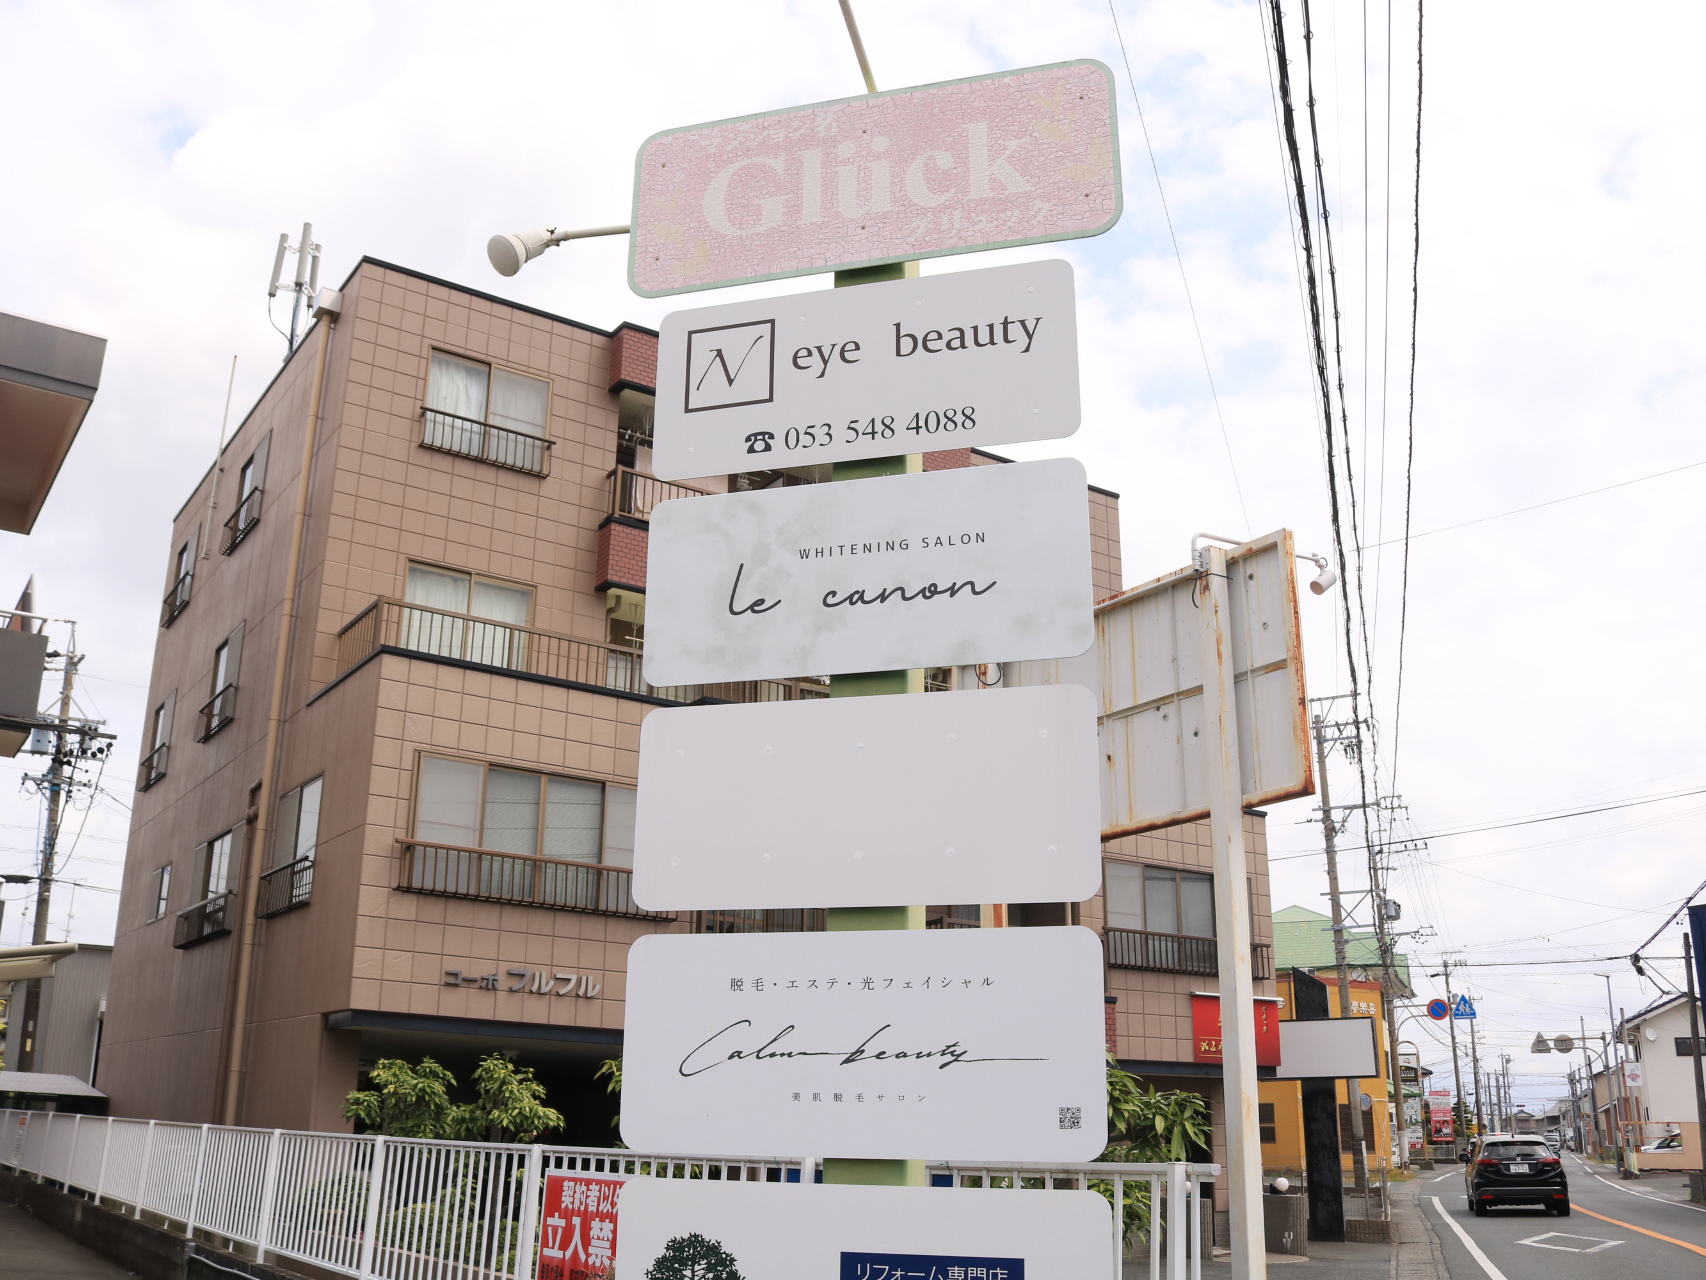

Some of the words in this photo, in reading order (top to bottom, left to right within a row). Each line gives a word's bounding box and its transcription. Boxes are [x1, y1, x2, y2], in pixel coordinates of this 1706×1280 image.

[702, 121, 1033, 237] Glück
[791, 339, 861, 379] eye
[892, 315, 1043, 358] beauty
[784, 422, 833, 451] 053
[845, 416, 896, 443] 548
[905, 405, 977, 436] 4088
[799, 539, 909, 560] WHITENING
[922, 532, 986, 549] SALON
[822, 580, 997, 608] canon
[508, 969, 600, 998] フルフル
[729, 976, 996, 992] 脱毛・エステ・光フェイシャル
[679, 1019, 830, 1077] Calm
[838, 1024, 1049, 1069] beauty
[791, 1091, 927, 1103] 美肌脱毛サロン
[542, 1212, 614, 1267] 立入禁
